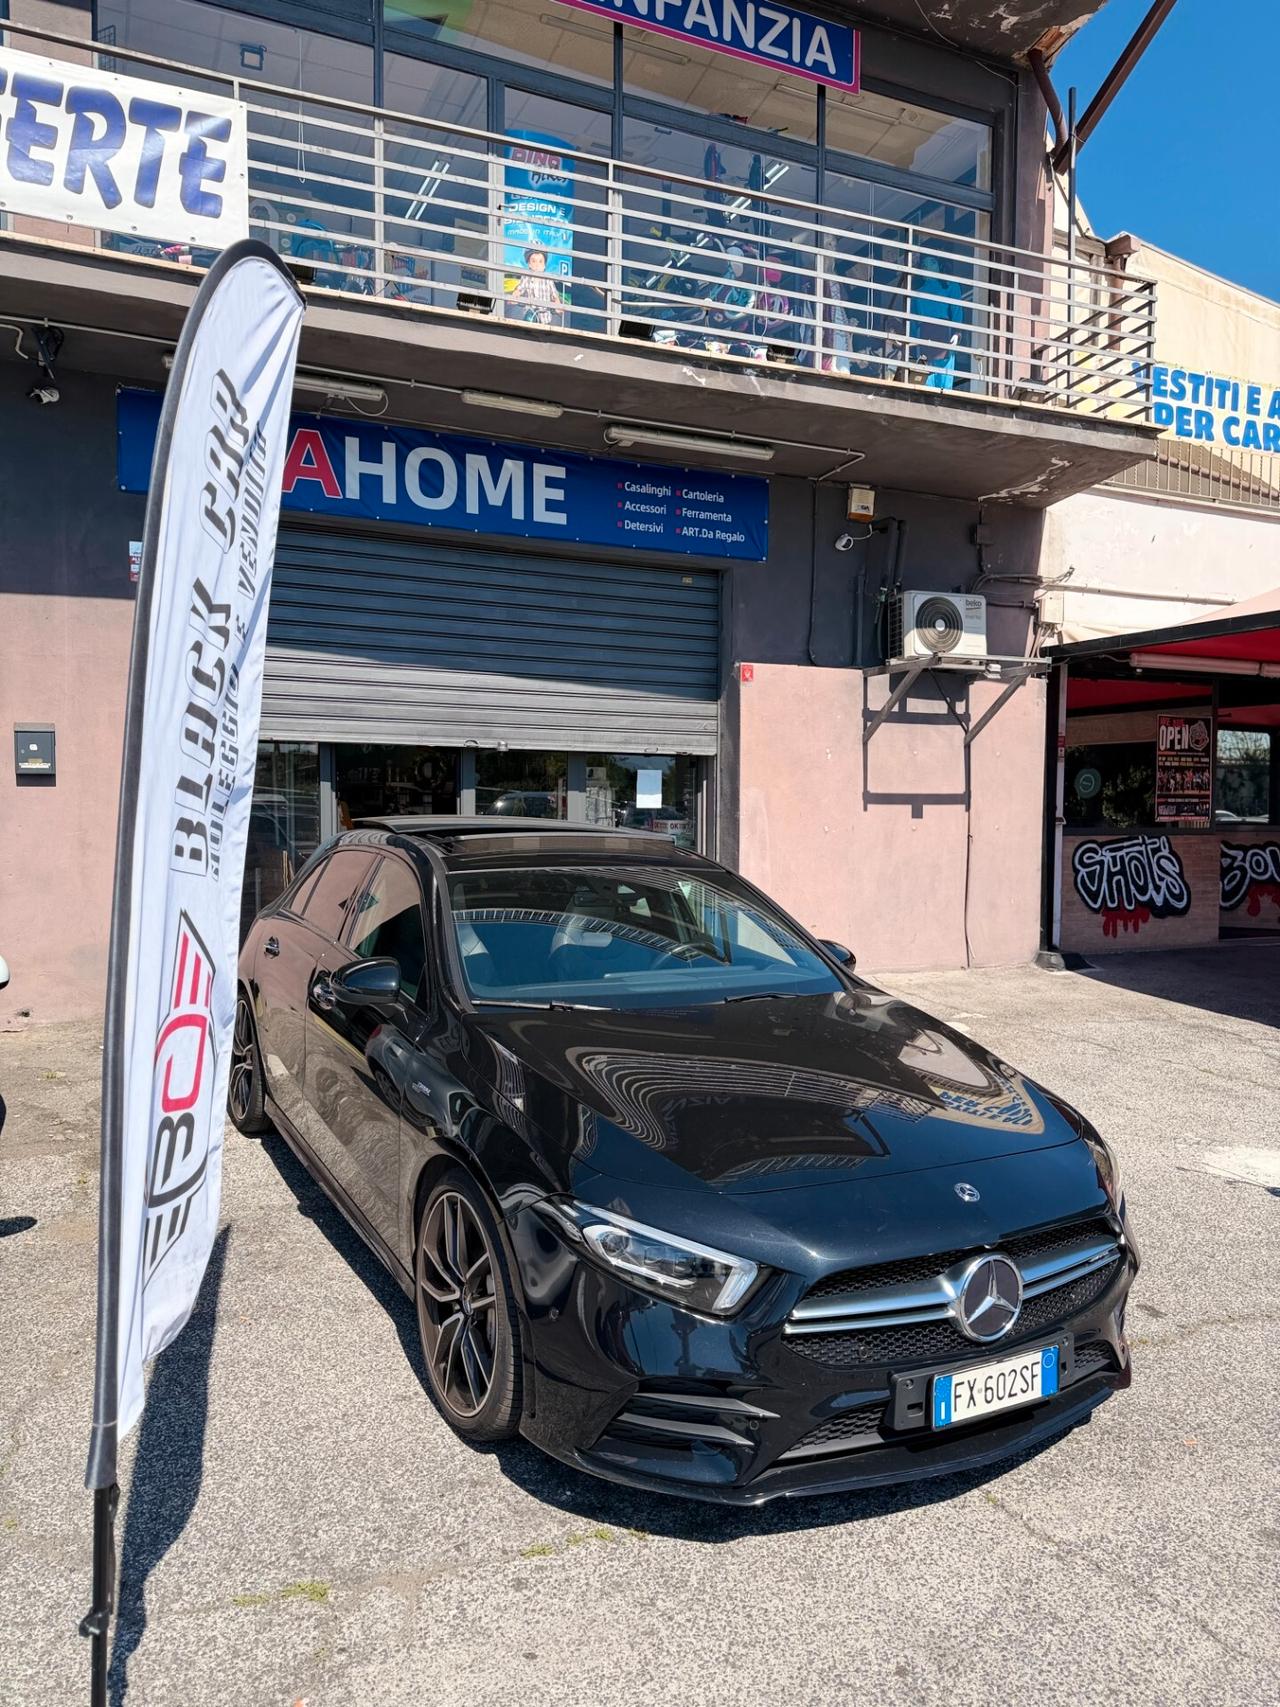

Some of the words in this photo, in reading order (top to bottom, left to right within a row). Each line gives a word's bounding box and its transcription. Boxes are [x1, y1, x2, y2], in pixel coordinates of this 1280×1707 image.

[615, 0, 836, 75] FANZIA
[0, 68, 232, 219] ERTE
[1246, 385, 1261, 416] E
[624, 482, 671, 497] Casalinghi
[682, 489, 724, 503] Cartoleria
[624, 501, 667, 515] Accessori
[682, 508, 732, 522] Ferramenta
[624, 520, 664, 533] Detersivi
[716, 530, 745, 543] Regalo
[170, 577, 231, 877] BLACK
[1160, 724, 1189, 750] OPEN
